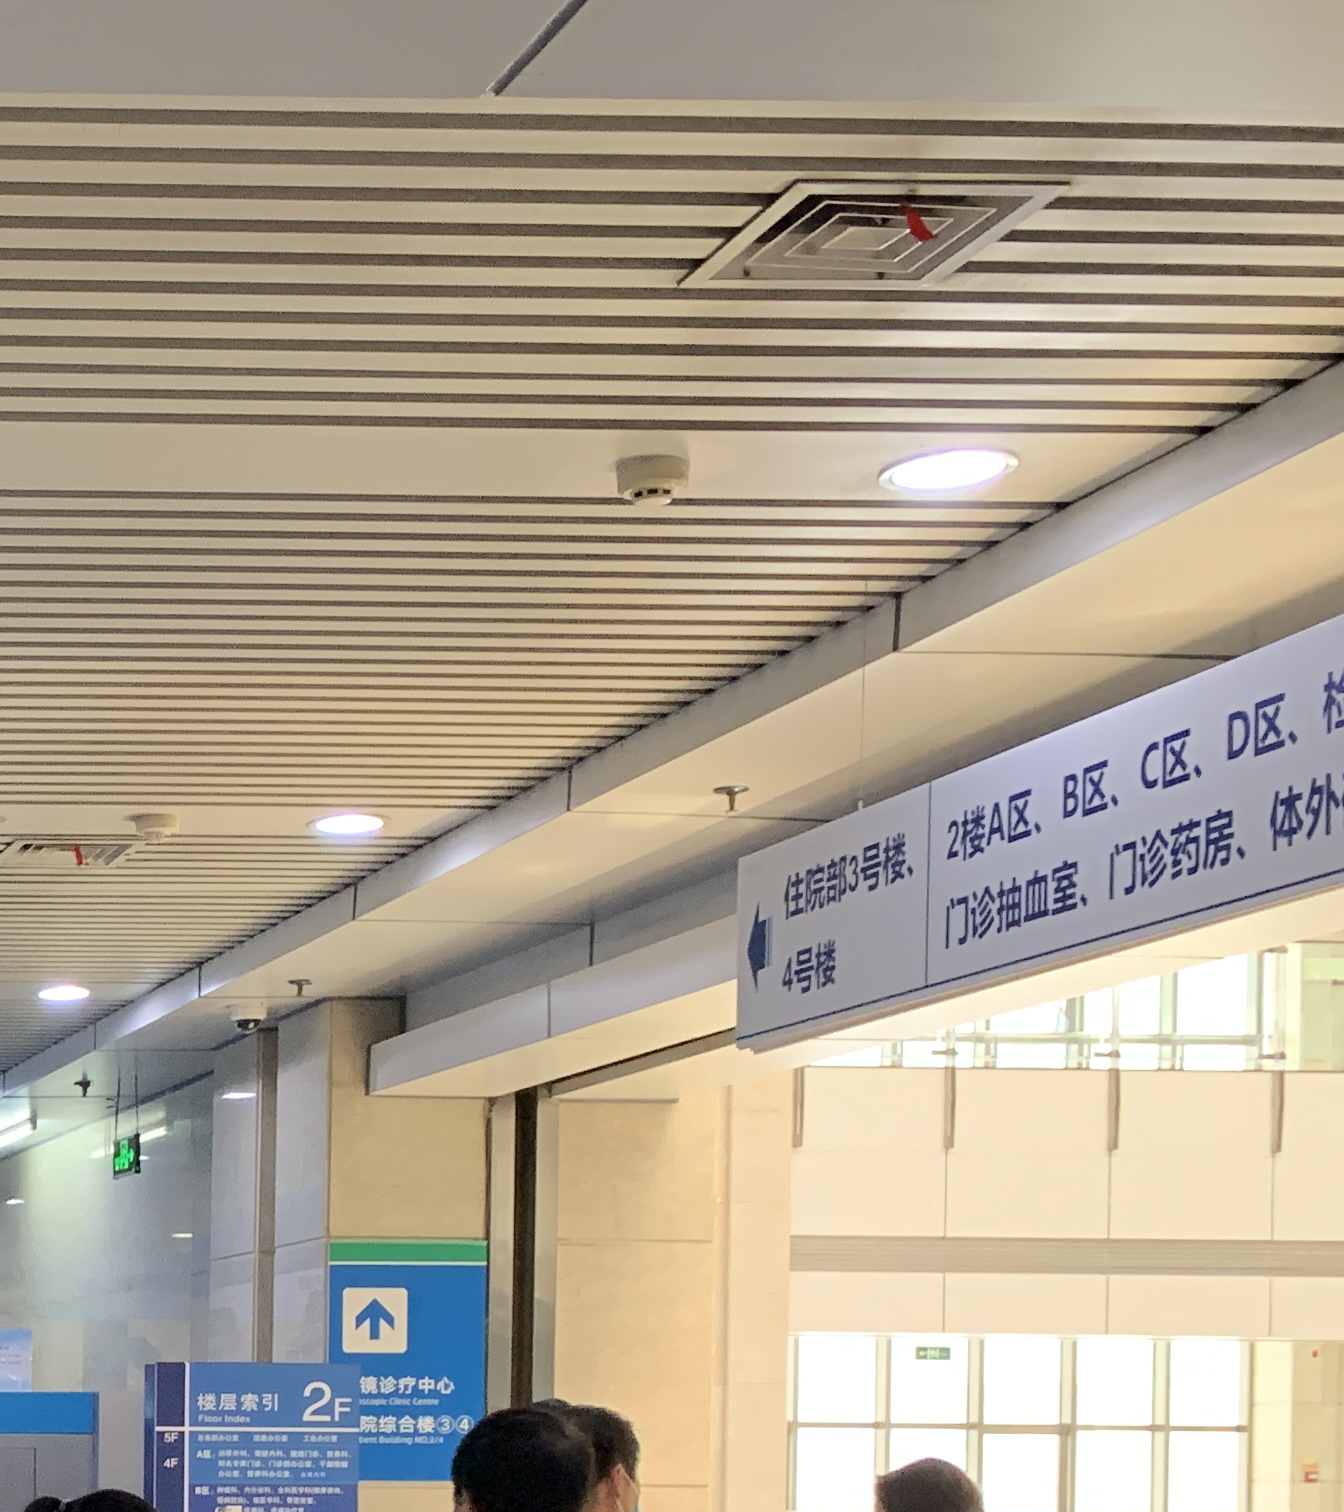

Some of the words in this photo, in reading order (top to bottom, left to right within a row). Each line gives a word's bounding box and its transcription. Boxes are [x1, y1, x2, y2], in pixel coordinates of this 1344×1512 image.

[944, 773, 1344, 949] 门诊抽血室、门诊药房、体外
[783, 833, 914, 920] 住院部3号楼、
[782, 940, 836, 994] 4号楼
[359, 1376, 455, 1395] 镜诊疗中心
[197, 1393, 279, 1412] 楼层索引
[302, 1382, 352, 1422] 2F
[198, 1414, 222, 1423] Floor
[224, 1414, 251, 1423] Index
[163, 1433, 179, 1443] 5F
[163, 1458, 179, 1468] 4F
